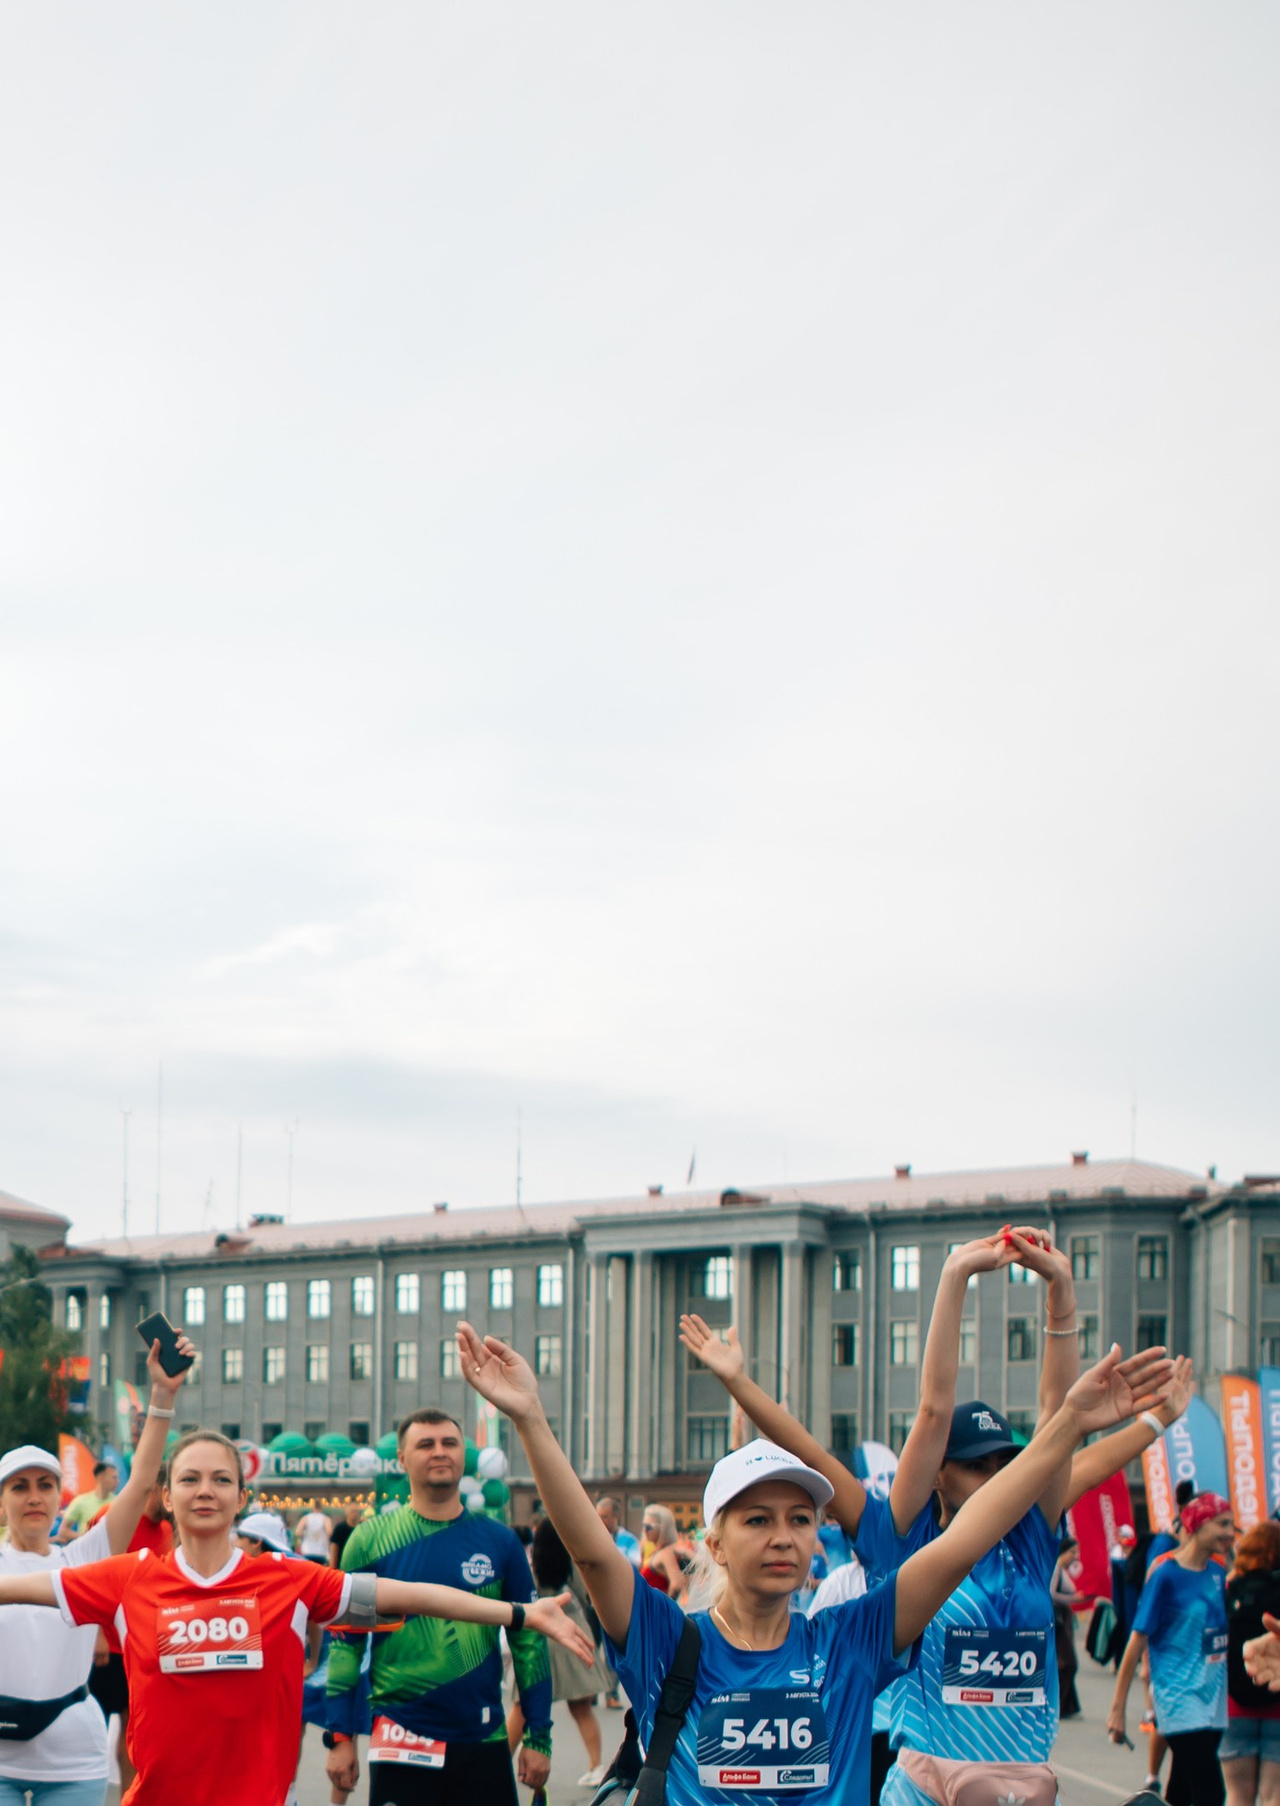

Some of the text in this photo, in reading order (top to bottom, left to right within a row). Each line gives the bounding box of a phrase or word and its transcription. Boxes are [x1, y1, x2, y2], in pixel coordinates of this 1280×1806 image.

[168, 1616, 249, 1645] 2080
[959, 1650, 1037, 1676] 5420
[721, 1717, 812, 1750] 5416
